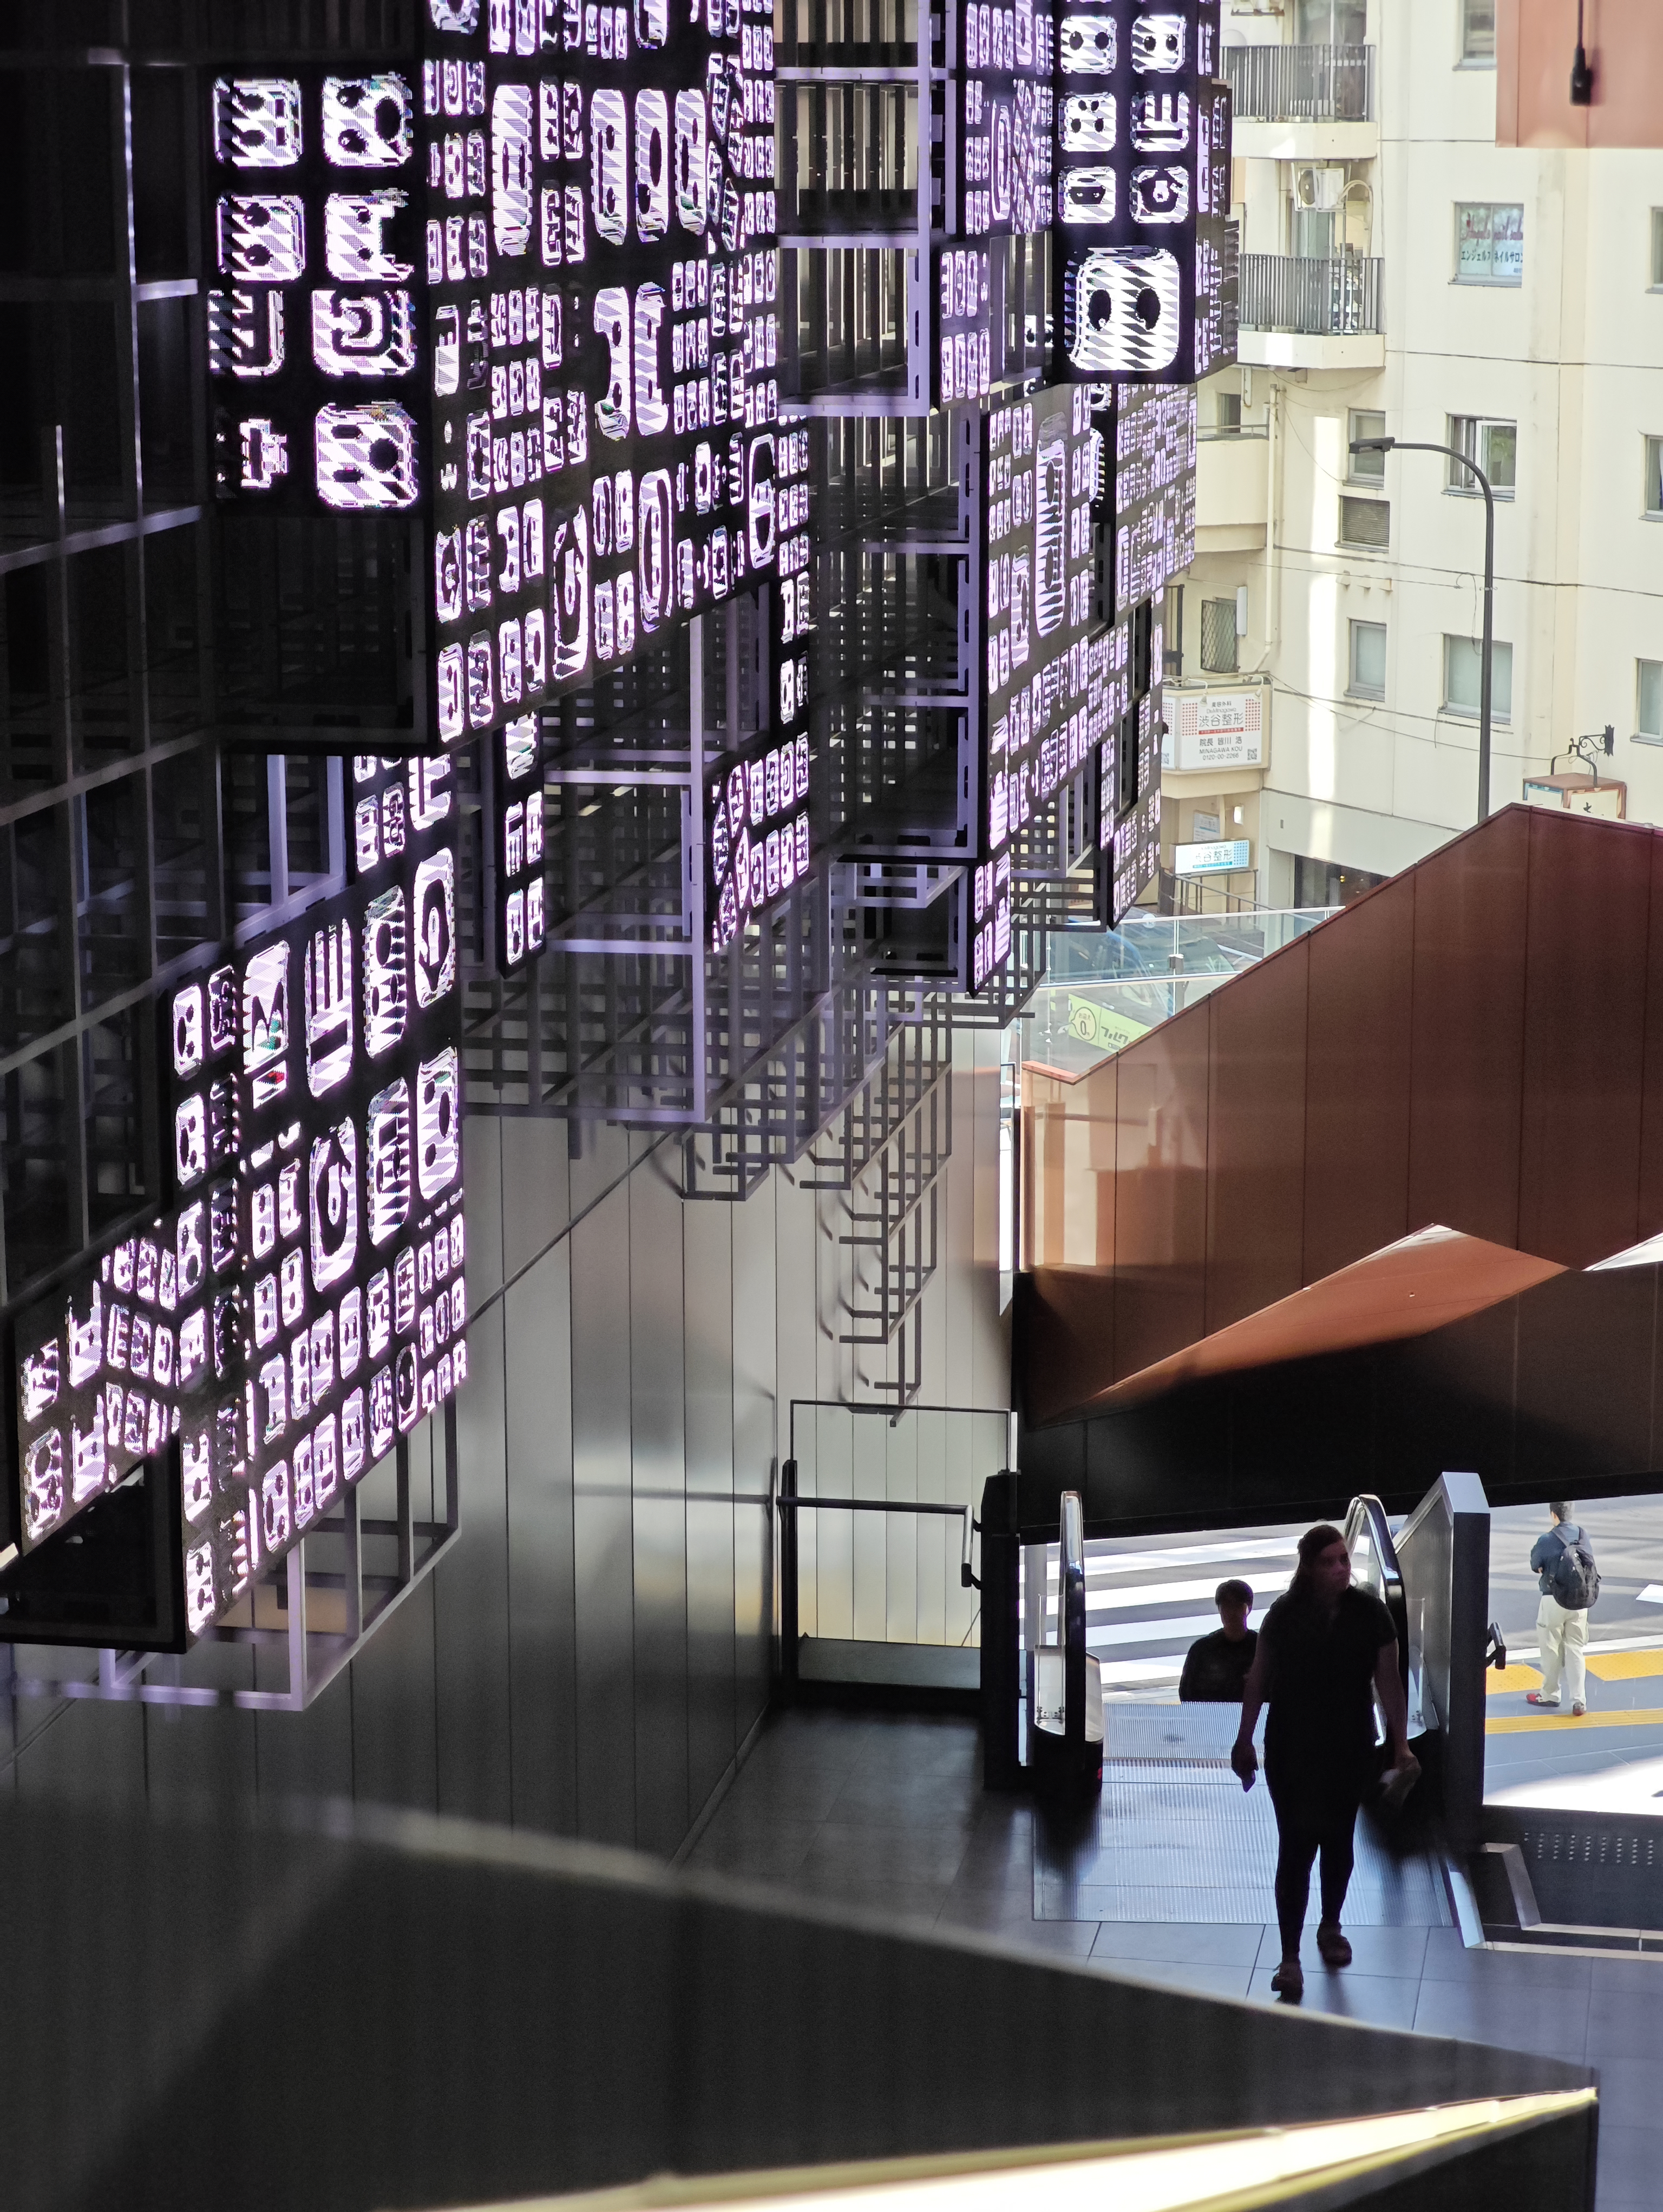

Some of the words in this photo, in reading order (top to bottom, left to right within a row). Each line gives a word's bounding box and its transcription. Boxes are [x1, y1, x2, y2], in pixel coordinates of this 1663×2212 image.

[1199, 712, 1244, 727] 渋谷整形
[1199, 738, 1214, 747] 院長
[1217, 736, 1232, 746] 皆川
